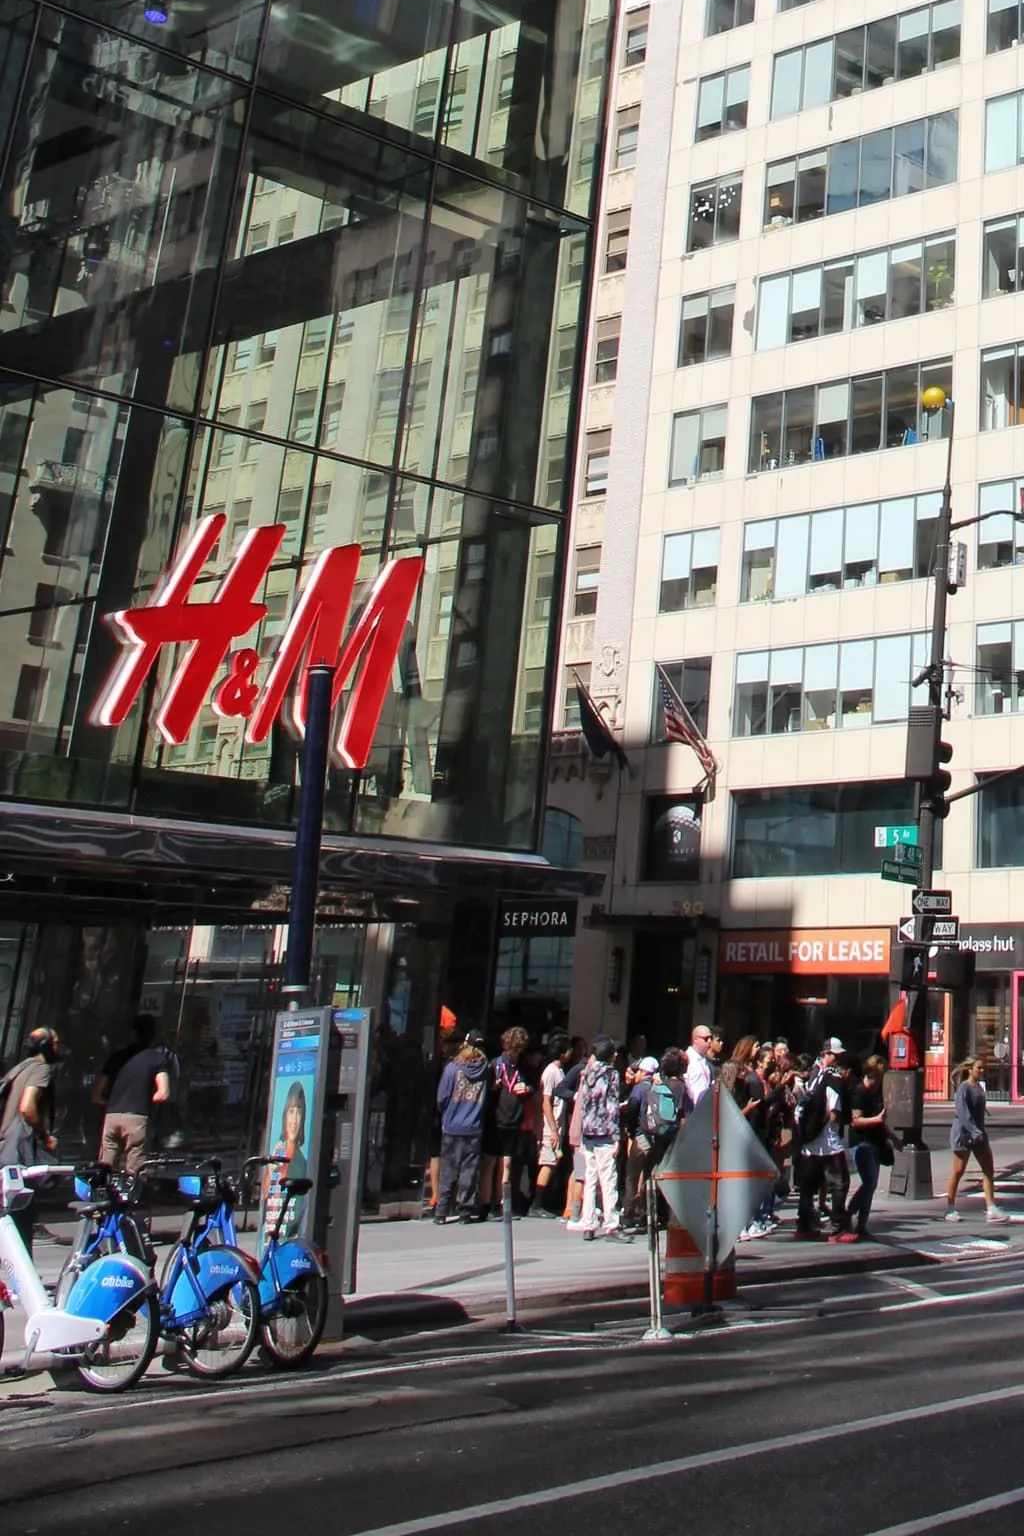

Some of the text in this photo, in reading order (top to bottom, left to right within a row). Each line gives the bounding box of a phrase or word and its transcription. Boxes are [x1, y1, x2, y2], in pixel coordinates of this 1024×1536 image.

[98, 513, 424, 769] H&M
[893, 829, 899, 844] 5
[916, 897, 949, 907] ONE WAY
[503, 911, 568, 926] SEPHORA
[933, 923, 954, 934] WAY
[993, 935, 1014, 951] hut
[725, 940, 885, 962] RETAIL FOR LEASE
